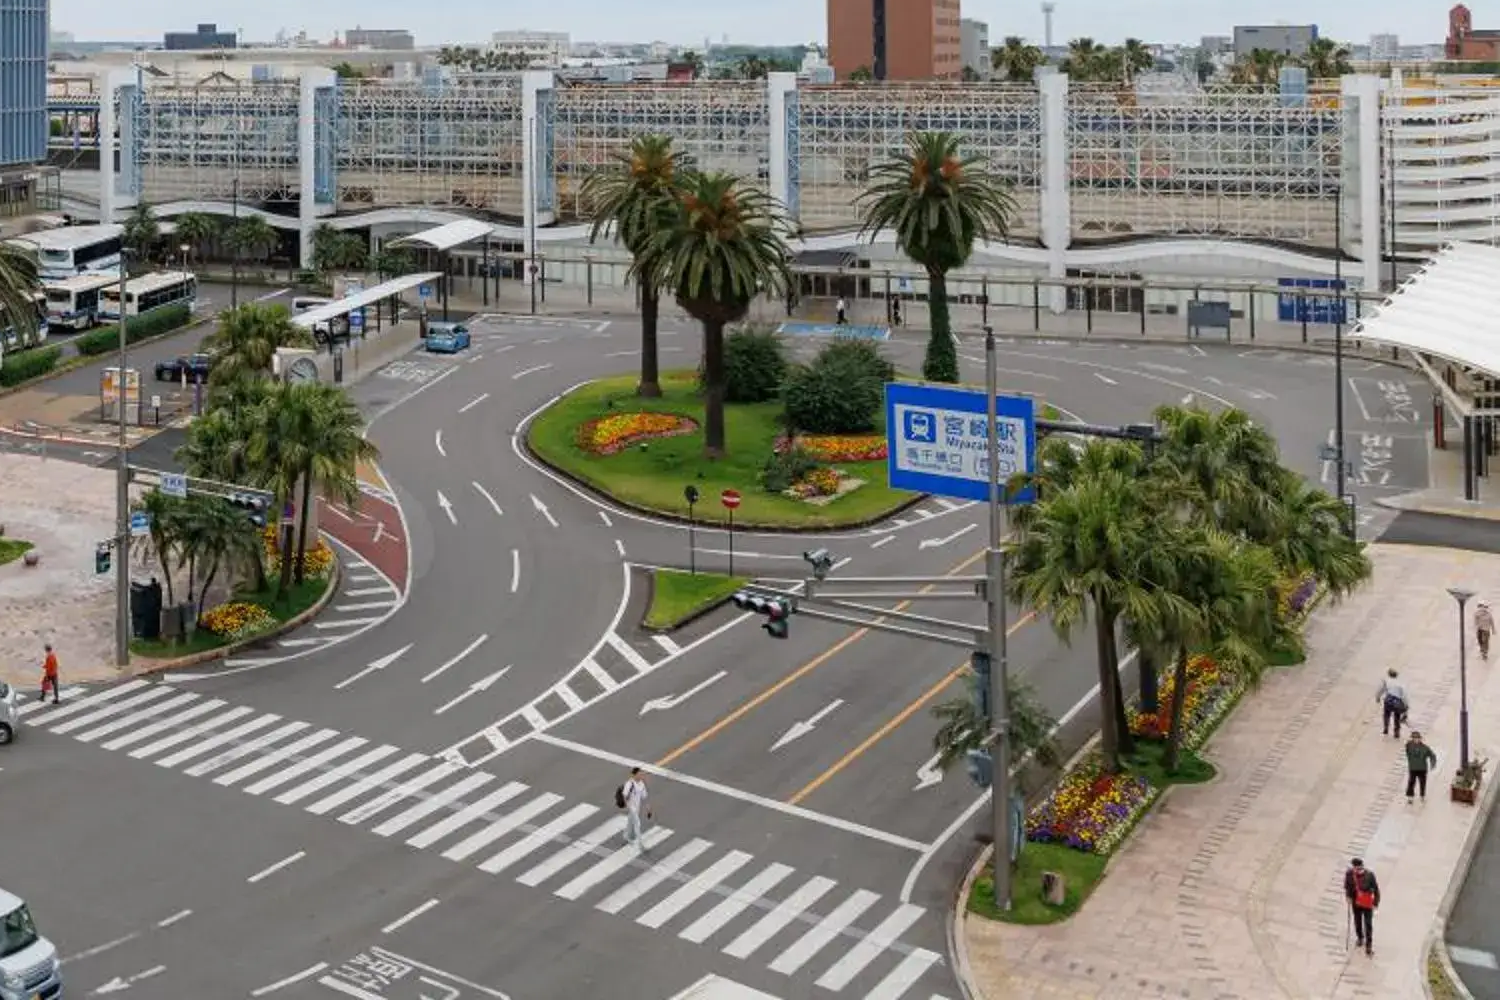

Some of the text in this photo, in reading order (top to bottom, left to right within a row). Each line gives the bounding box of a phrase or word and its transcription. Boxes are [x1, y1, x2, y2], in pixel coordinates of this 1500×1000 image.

[945, 416, 1017, 441] 宮崎駅
[332, 951, 413, 992] 原付
